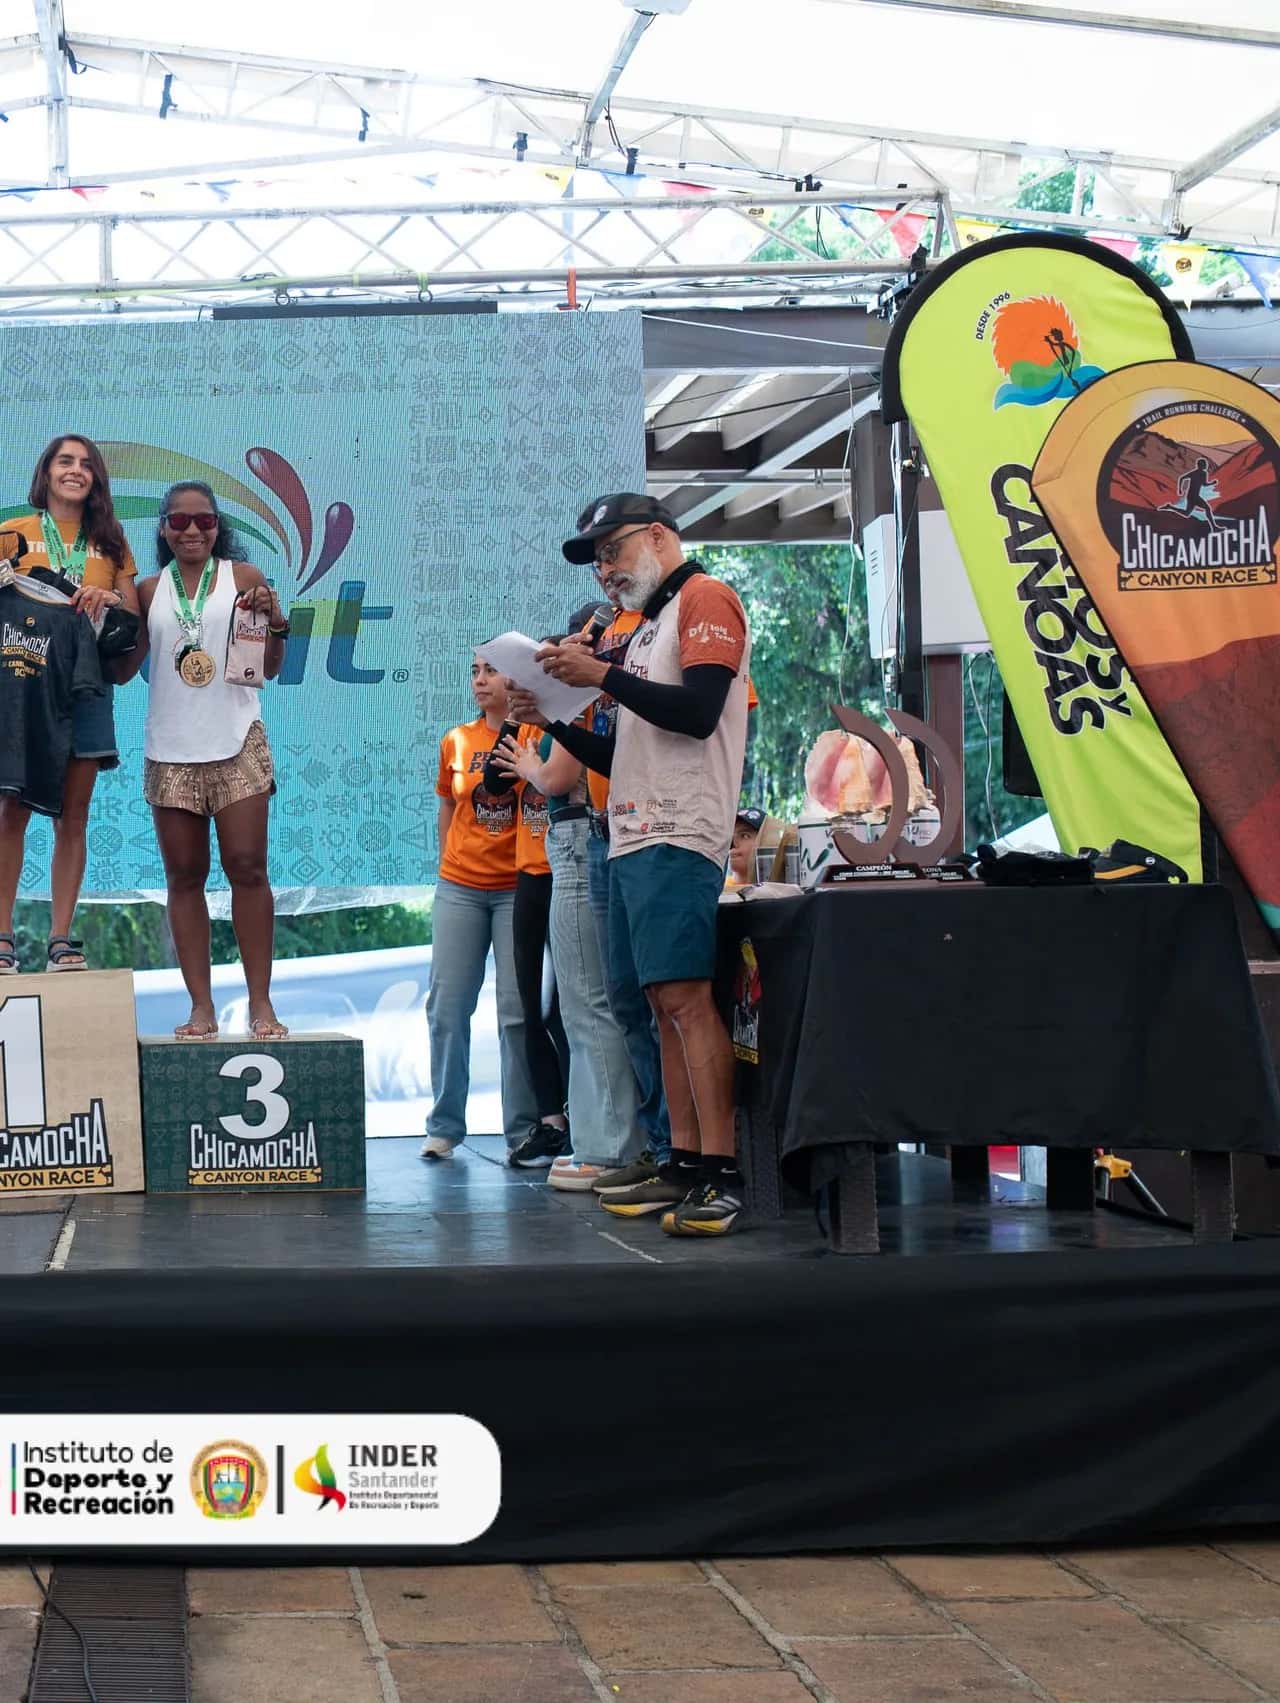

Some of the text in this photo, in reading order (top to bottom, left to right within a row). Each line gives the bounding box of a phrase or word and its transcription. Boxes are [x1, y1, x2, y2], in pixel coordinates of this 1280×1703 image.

[975, 292, 1010, 341] DESDE 1996
[1142, 411, 1163, 425] TRAIL
[1200, 403, 1241, 422] CHALLENGE
[1122, 505, 1272, 570] CHICAMOCHA
[990, 463, 1105, 736] CANOAS
[1137, 569, 1258, 587] CANYON RACE
[219, 1053, 290, 1140] 3
[190, 1121, 318, 1169] CHICAMOCHA
[49, 1169, 95, 1185] RACE
[203, 1170, 308, 1183] CANYON RACE
